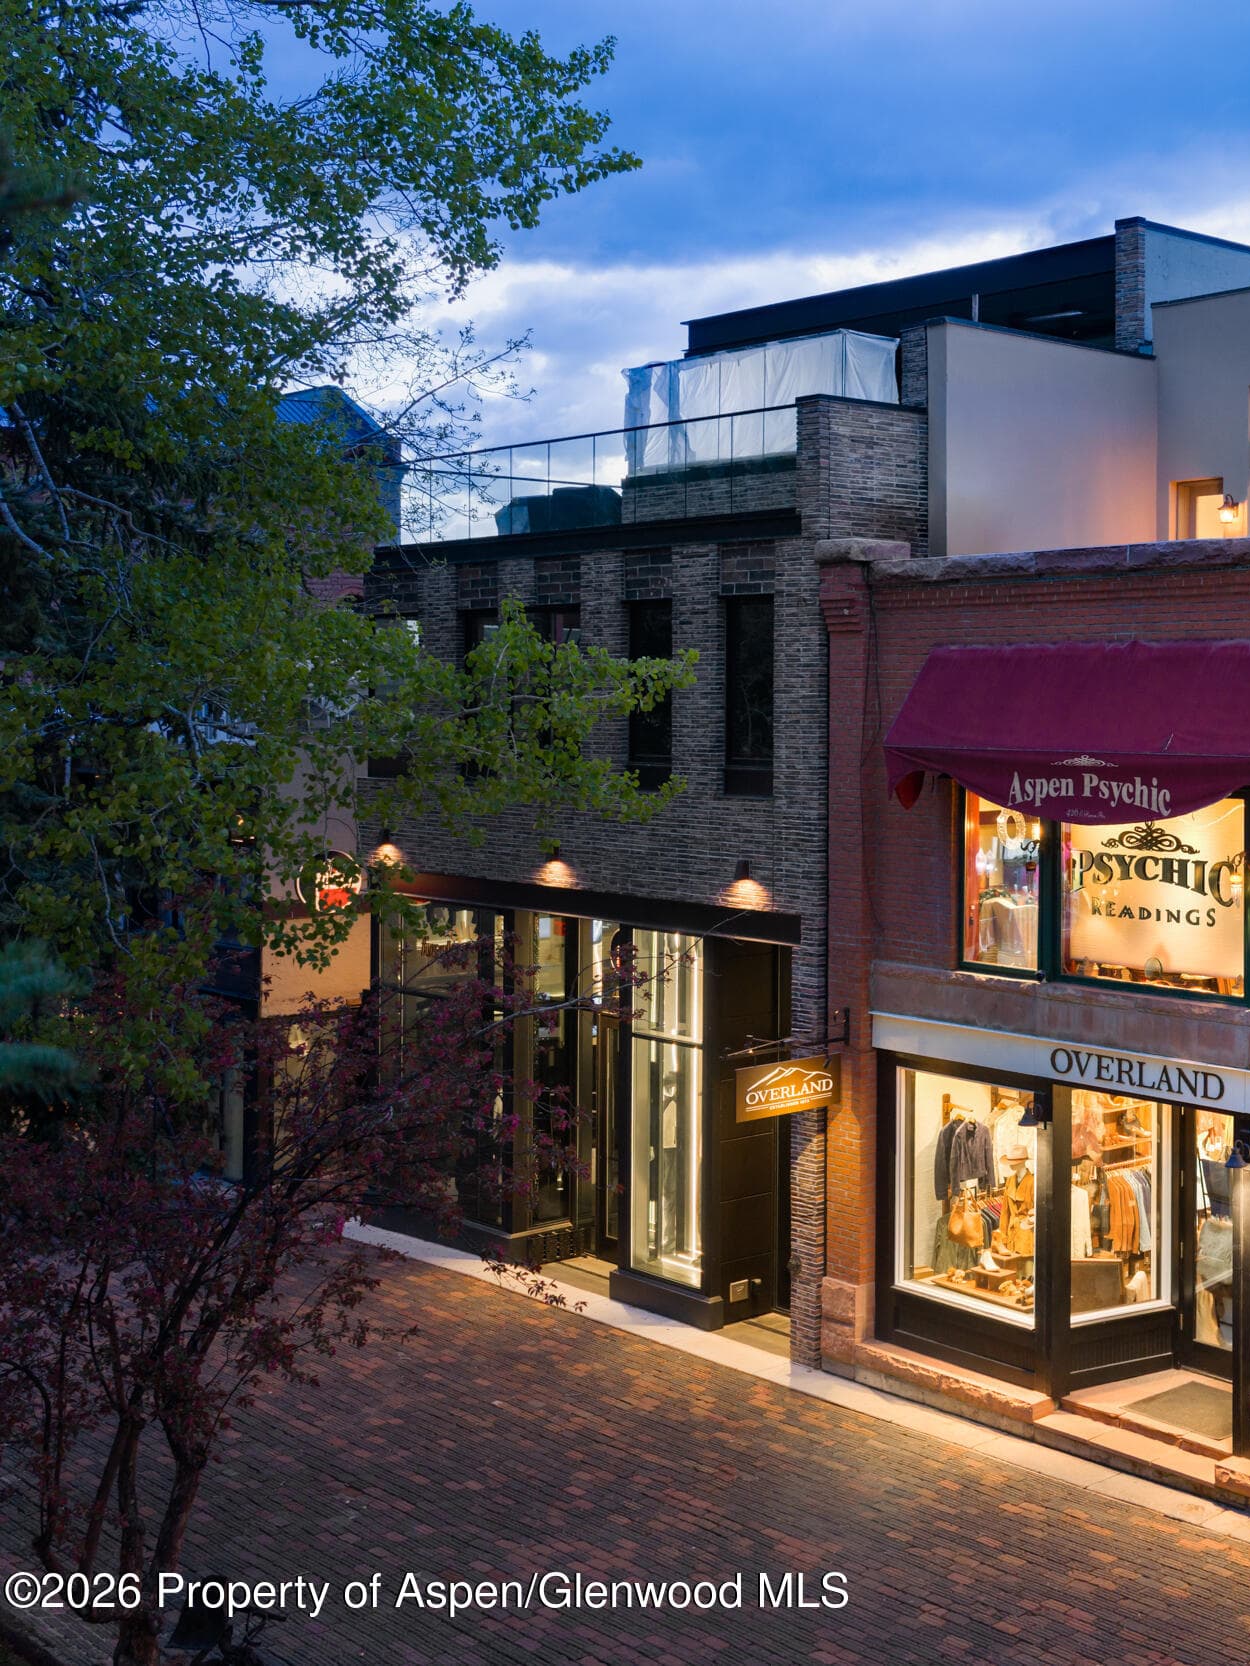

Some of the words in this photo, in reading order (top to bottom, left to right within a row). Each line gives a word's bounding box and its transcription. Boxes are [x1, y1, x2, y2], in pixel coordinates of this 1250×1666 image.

[1007, 771, 1075, 807] Aspen
[1081, 773, 1172, 816] Psychic
[1071, 849, 1236, 908] PSYCHIC
[1091, 896, 1217, 927] READINGS
[745, 1078, 833, 1105] OVERLAND
[1050, 1048, 1225, 1101] OVERLAND
